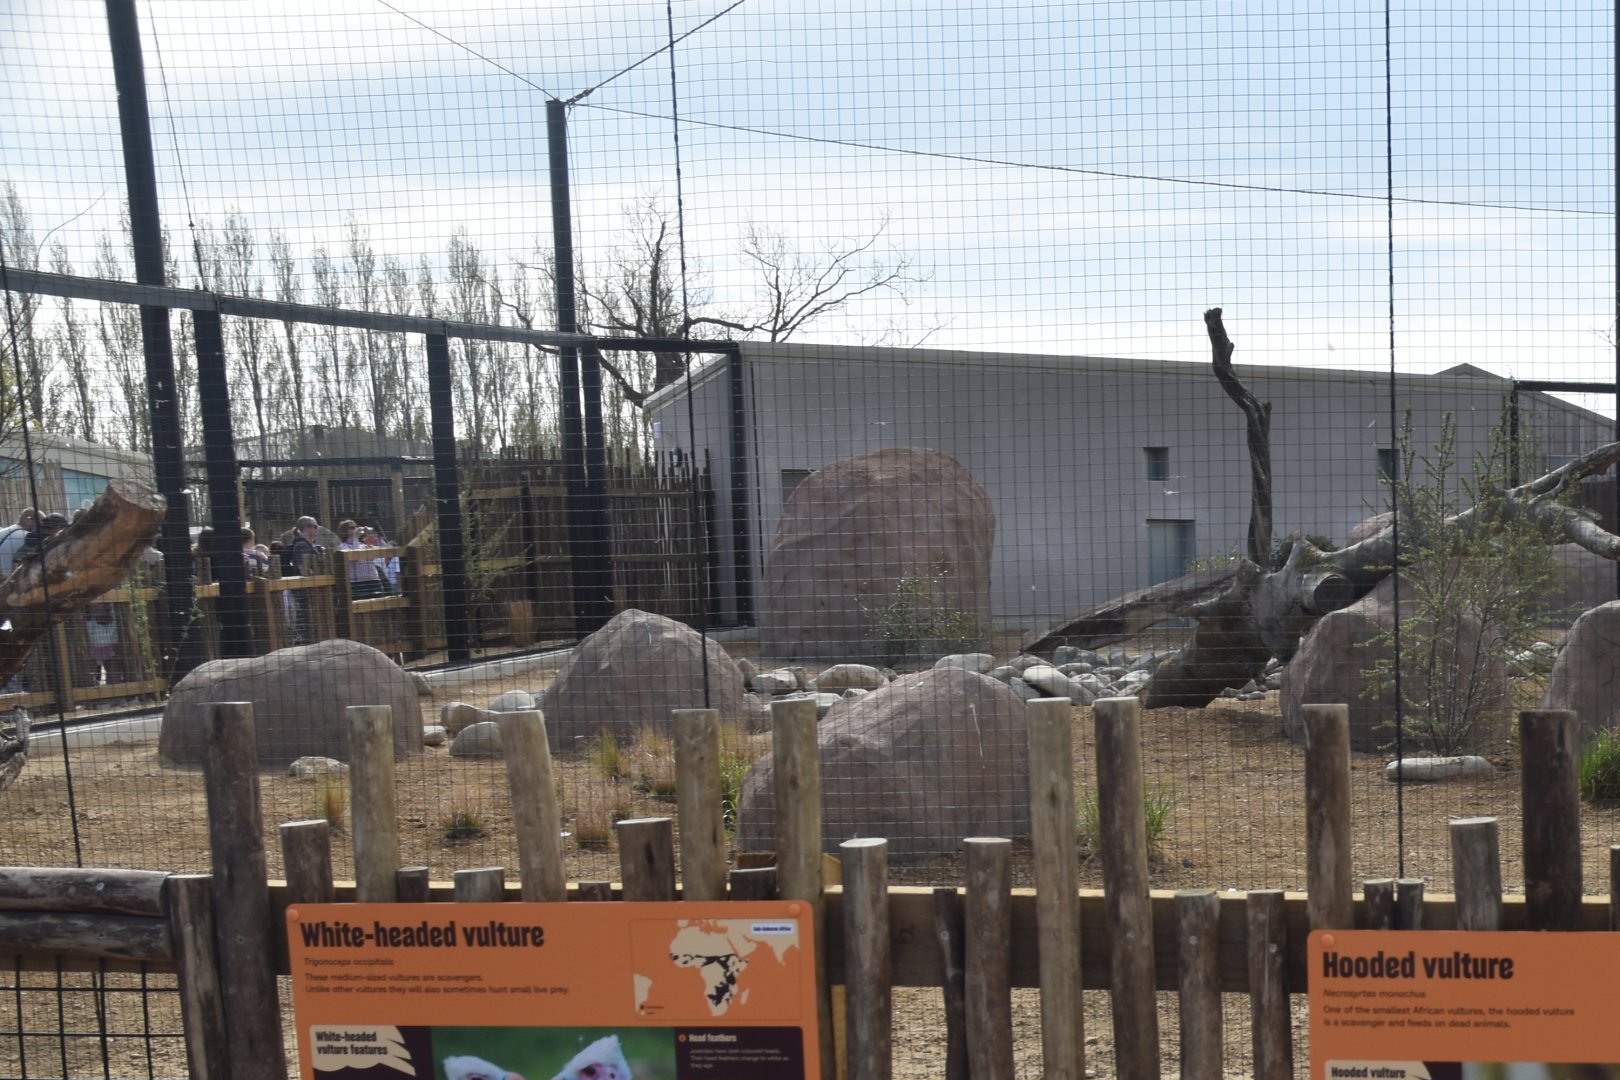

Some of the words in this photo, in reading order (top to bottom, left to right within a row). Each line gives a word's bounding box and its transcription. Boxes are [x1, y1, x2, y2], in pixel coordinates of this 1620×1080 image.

[300, 920, 457, 948] White-headed
[463, 920, 545, 948] vulture
[1322, 950, 1416, 979] Hooded
[1423, 951, 1514, 980] vulture
[304, 973, 328, 982] These
[329, 973, 387, 982] medium-sized
[388, 973, 420, 982] vultures
[305, 985, 330, 994] Unlike
[331, 985, 353, 994] other
[354, 985, 387, 994] vultures
[388, 985, 406, 996] they
[408, 985, 422, 994] will
[423, 985, 441, 994] also
[442, 985, 487, 994] sometimes
[487, 985, 508, 994] hunt
[509, 985, 532, 995] small
[533, 986, 548, 995] live
[1322, 1005, 1341, 1016] One
[1354, 1005, 1370, 1016] the
[1371, 1005, 1410, 1016] smallest
[1412, 1005, 1445, 1016] African
[1487, 1006, 1504, 1017] the
[1505, 1006, 1541, 1017] hooded
[1542, 1006, 1576, 1018] vulture
[1340, 1020, 1385, 1029] scavenger
[1387, 1018, 1405, 1027] and
[1406, 1018, 1432, 1027] feeds
[1447, 1018, 1471, 1027] dead
[314, 1031, 378, 1042] White-headed
[688, 1033, 706, 1042] Head
[706, 1033, 738, 1042] feathers
[316, 1044, 348, 1055] vulture
[349, 1044, 388, 1056] features
[1331, 1067, 1368, 1078] Hooded
[1370, 1067, 1406, 1078] vulture
